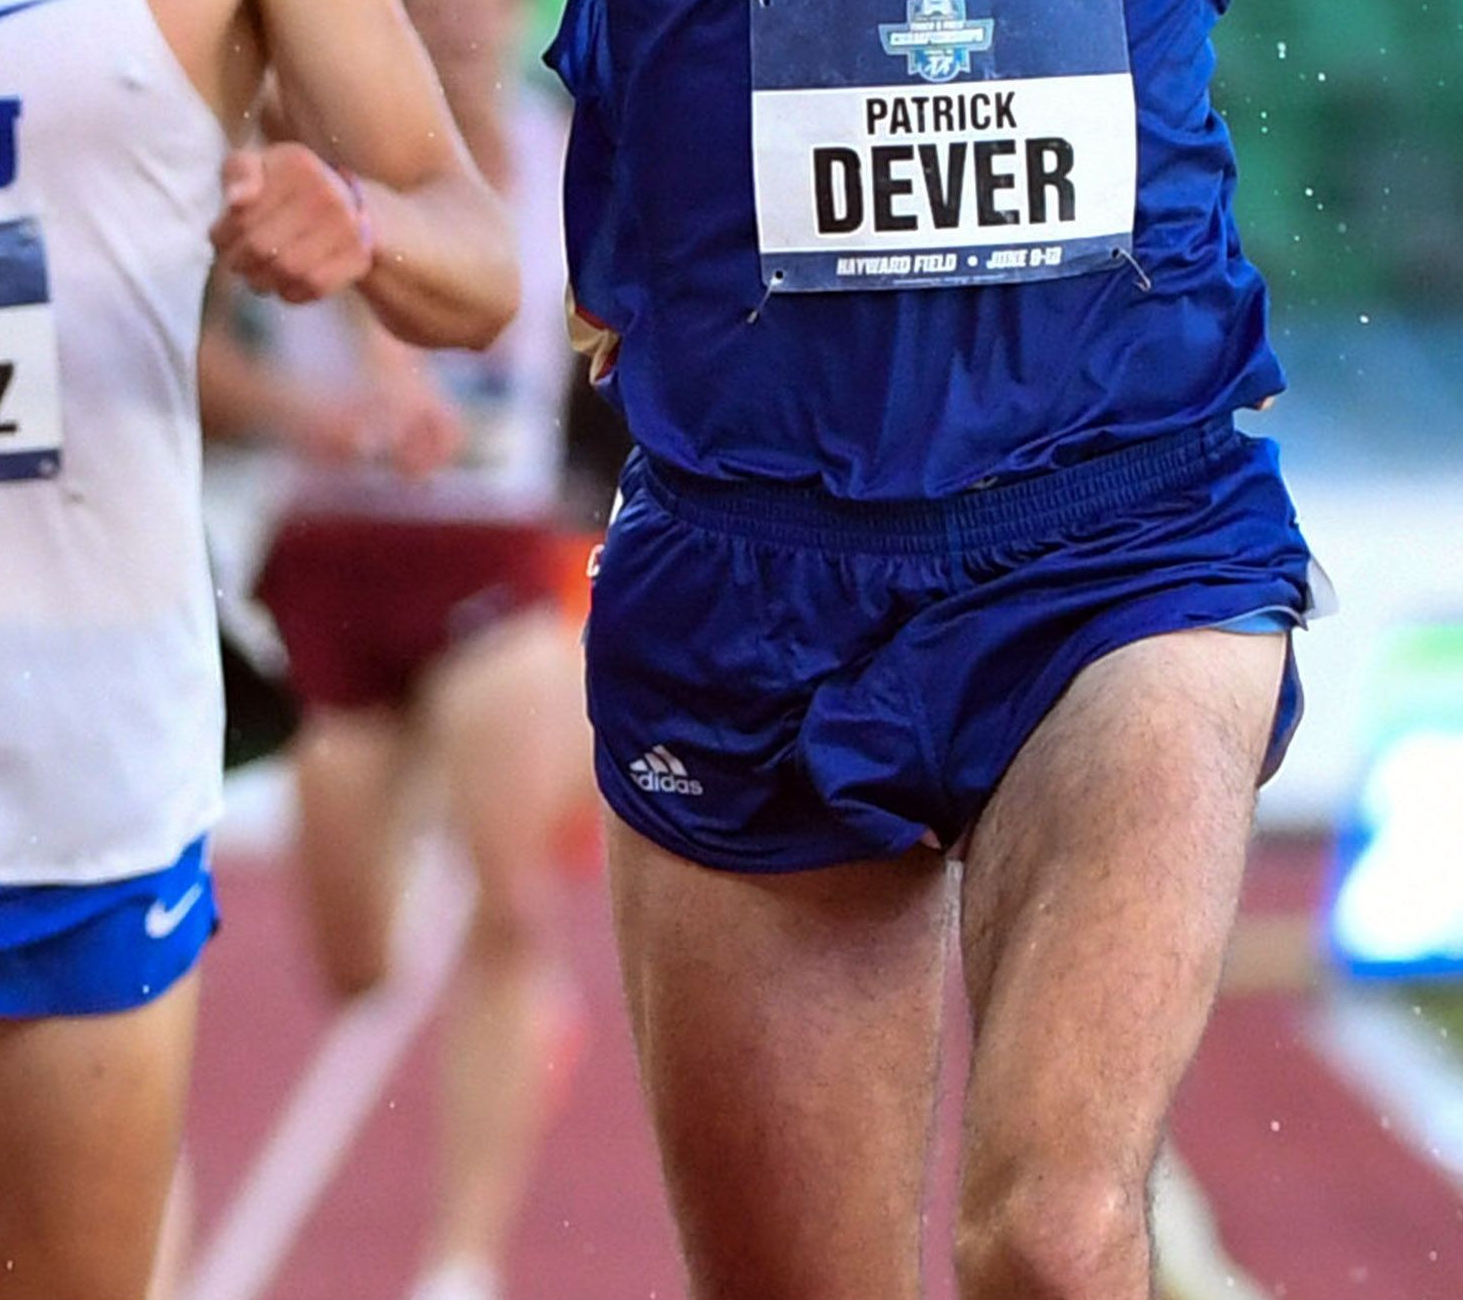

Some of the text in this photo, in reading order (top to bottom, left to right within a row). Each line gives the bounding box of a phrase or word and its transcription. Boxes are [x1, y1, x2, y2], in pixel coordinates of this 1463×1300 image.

[865, 91, 1018, 136] PATRICK
[812, 137, 1077, 235] DEVER
[913, 253, 957, 273] FIELD
